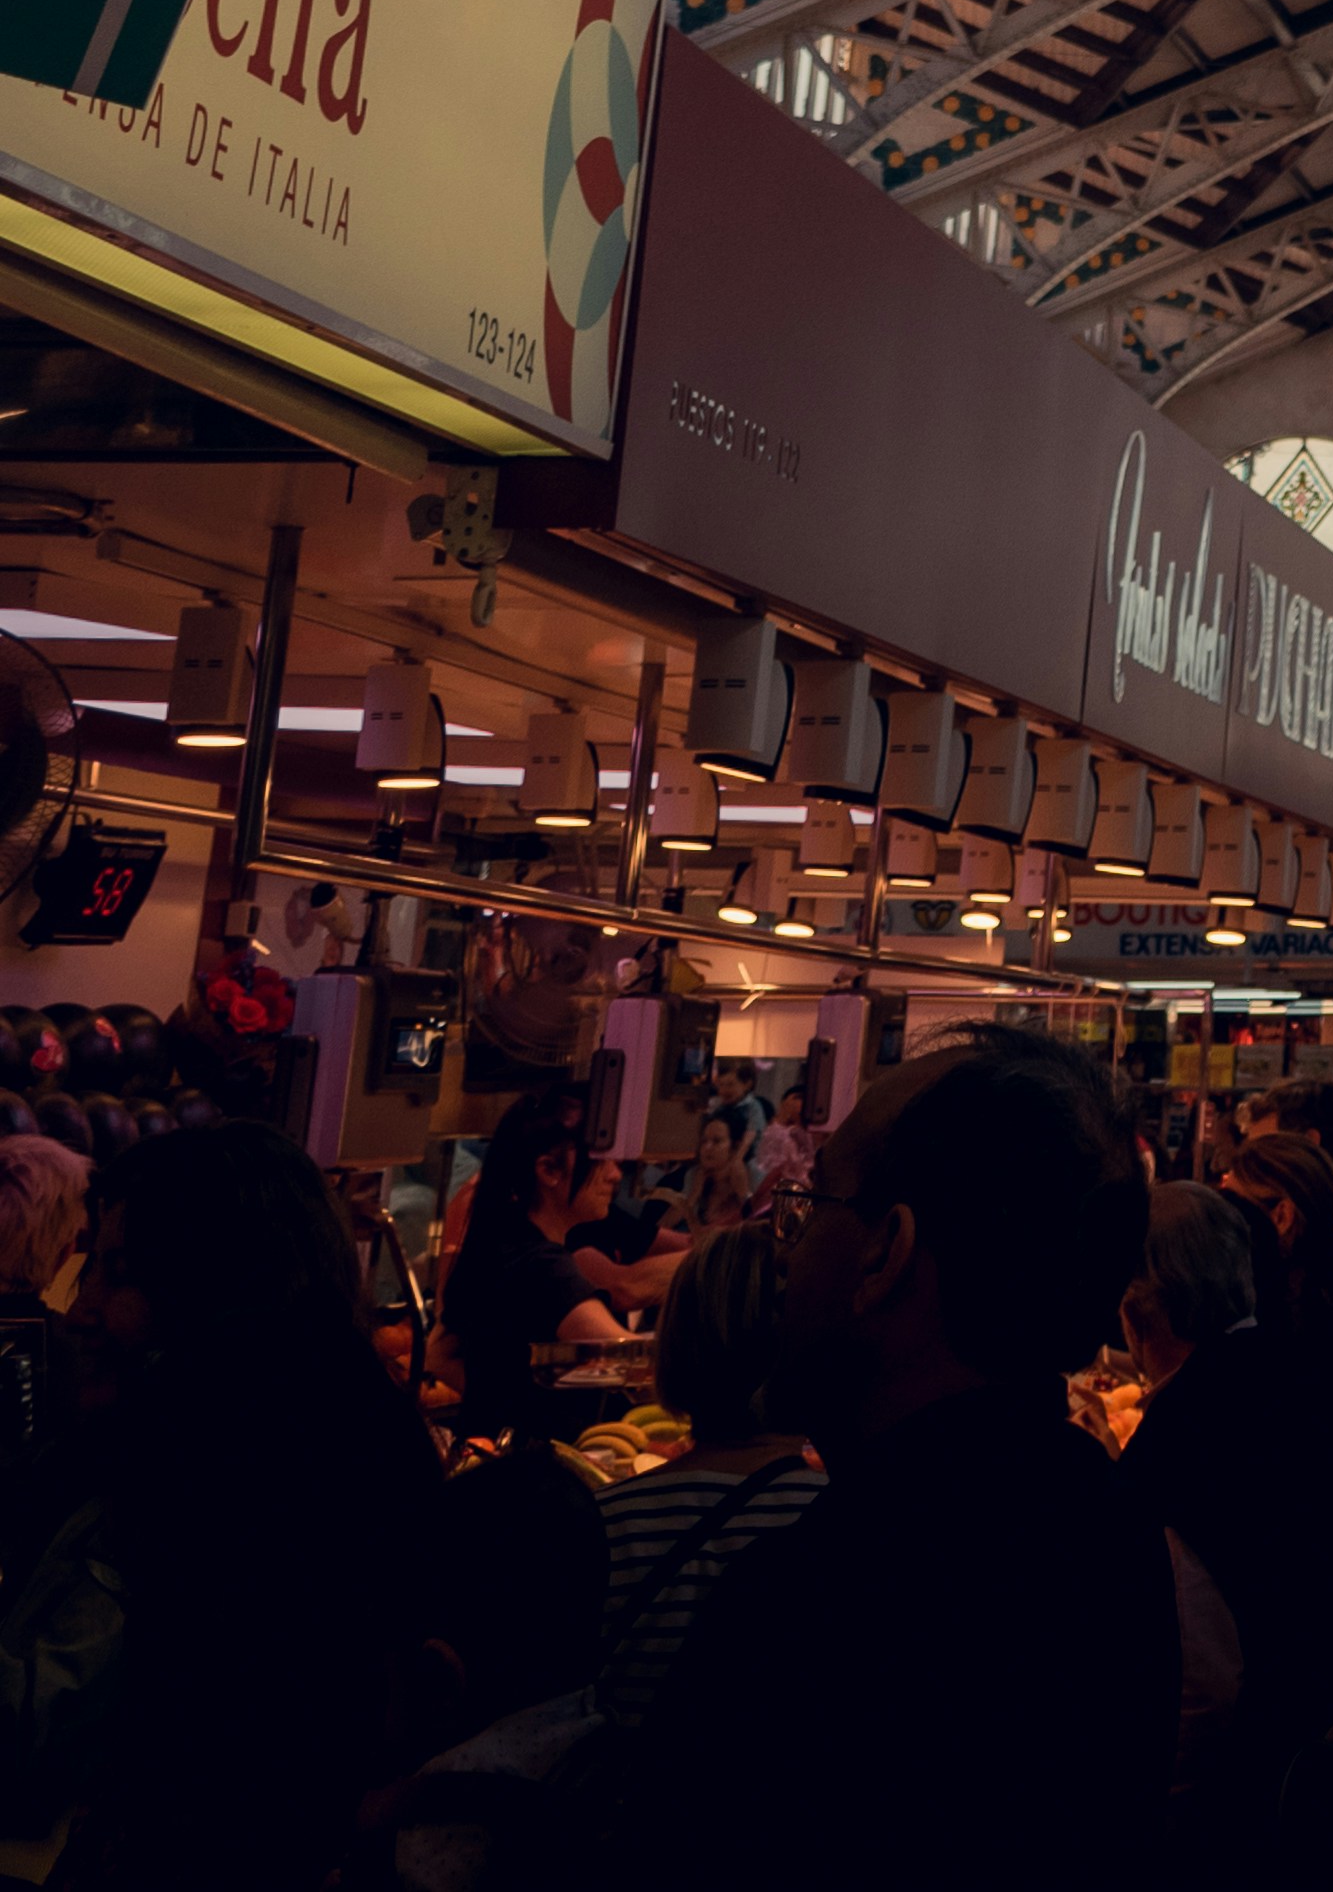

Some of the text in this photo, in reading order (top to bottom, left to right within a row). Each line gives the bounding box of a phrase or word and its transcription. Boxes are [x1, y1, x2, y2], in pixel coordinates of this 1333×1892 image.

[186, 103, 233, 181] DE
[248, 137, 350, 246] ITALIA
[467, 306, 536, 385] 123-124
[670, 380, 735, 451] PUESTOS
[82, 866, 134, 917] 58
